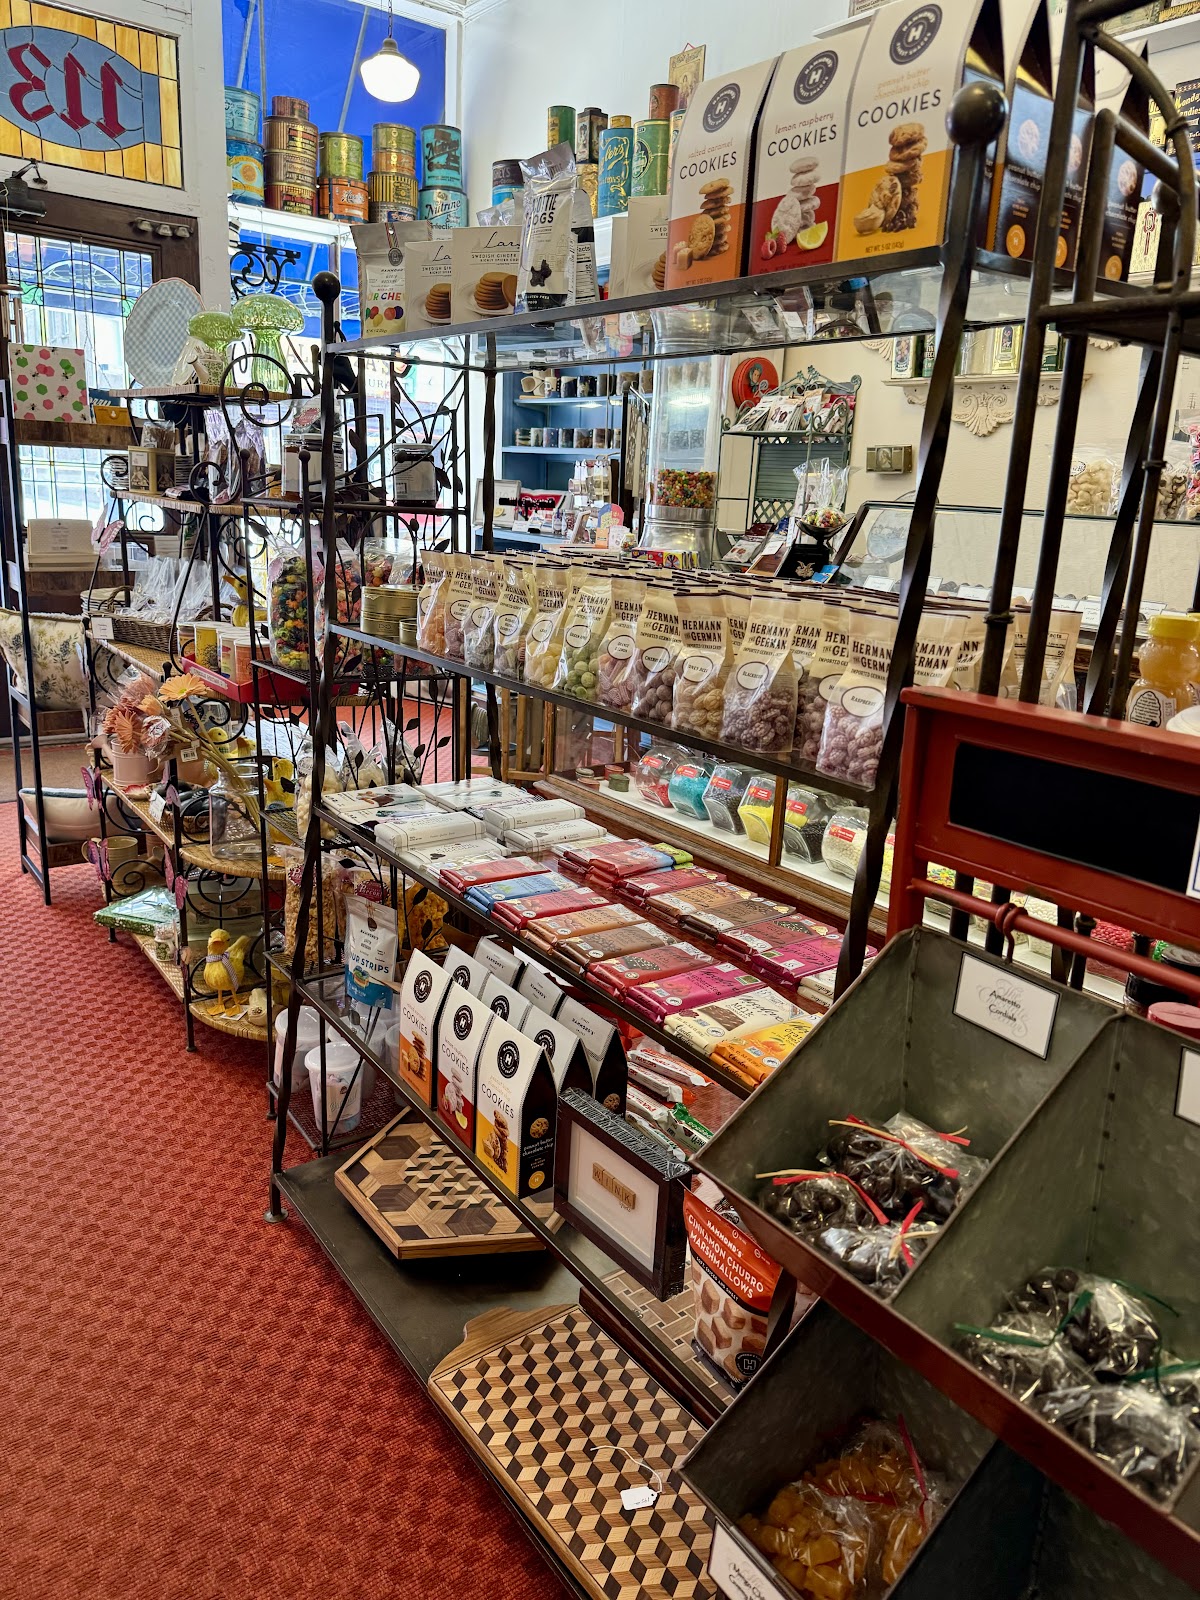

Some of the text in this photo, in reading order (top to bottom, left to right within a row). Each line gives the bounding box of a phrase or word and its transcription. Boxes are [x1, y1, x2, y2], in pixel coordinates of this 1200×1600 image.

[858, 89, 942, 128] COOKIES
[775, 111, 835, 135] lemon raspberry
[767, 124, 837, 157] COOKIES
[680, 151, 738, 180] COOKIES
[432, 246, 452, 262] La
[615, 601, 642, 612] HERMAN
[622, 612, 639, 622] GERM
[646, 610, 679, 625] HERMAN
[682, 620, 722, 631] HERMANN
[652, 622, 680, 637] GERMA
[691, 632, 722, 643] GERMAN
[751, 623, 790, 638] HERMANN
[796, 625, 822, 638] RMAN
[755, 636, 787, 650] GERMAN
[853, 641, 892, 659] HERMAN
[861, 657, 891, 673] GERMA
[361, 958, 389, 974] STRIPS
[989, 990, 1021, 1009] Amaretto
[403, 1007, 428, 1036] COOKIES
[988, 1004, 1017, 1022] Cordials
[442, 1044, 470, 1076] COOKIES
[481, 1083, 515, 1119] COOKIES
[687, 1214, 727, 1261] CINNAMON
[706, 1220, 743, 1259] HAMMOND'S
[690, 1230, 754, 1299] MARSHMALLOWS
[726, 1255, 765, 1294] CHURRO
